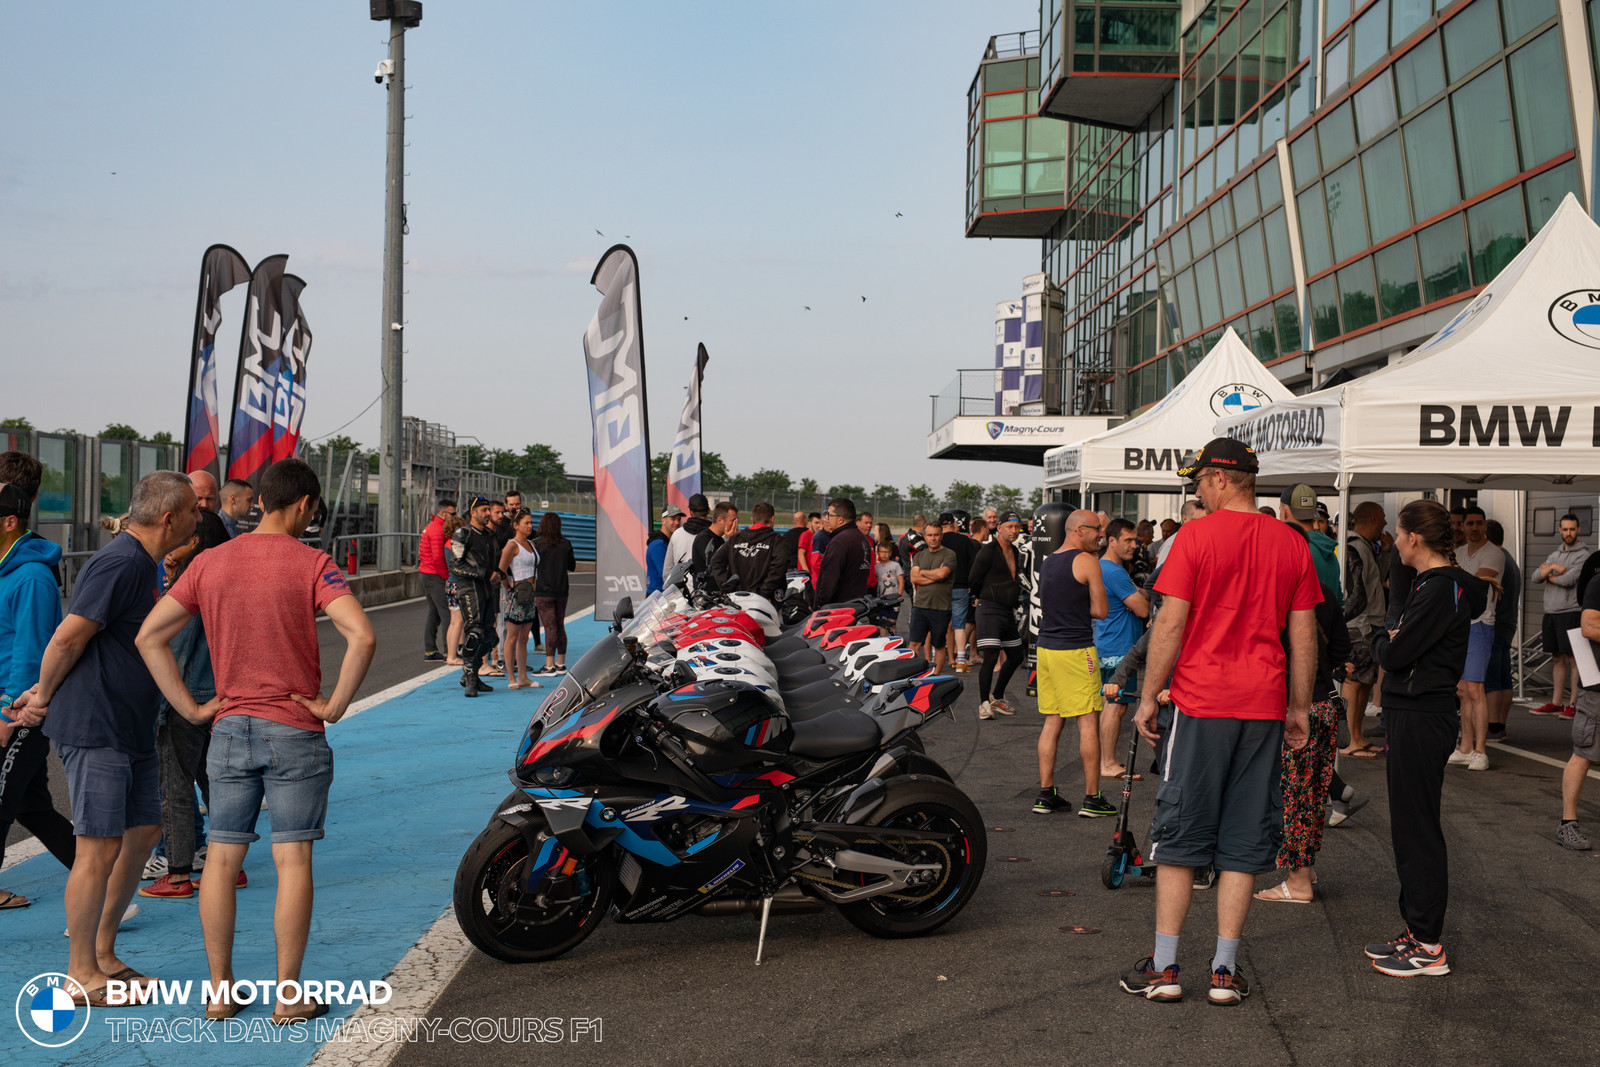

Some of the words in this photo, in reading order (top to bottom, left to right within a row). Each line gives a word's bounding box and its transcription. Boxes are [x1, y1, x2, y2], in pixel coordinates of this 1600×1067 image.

[1255, 406, 1325, 453] MOTORRAD
[1419, 404, 1572, 447] BMW
[713, 863, 740, 885] MICHELIN
